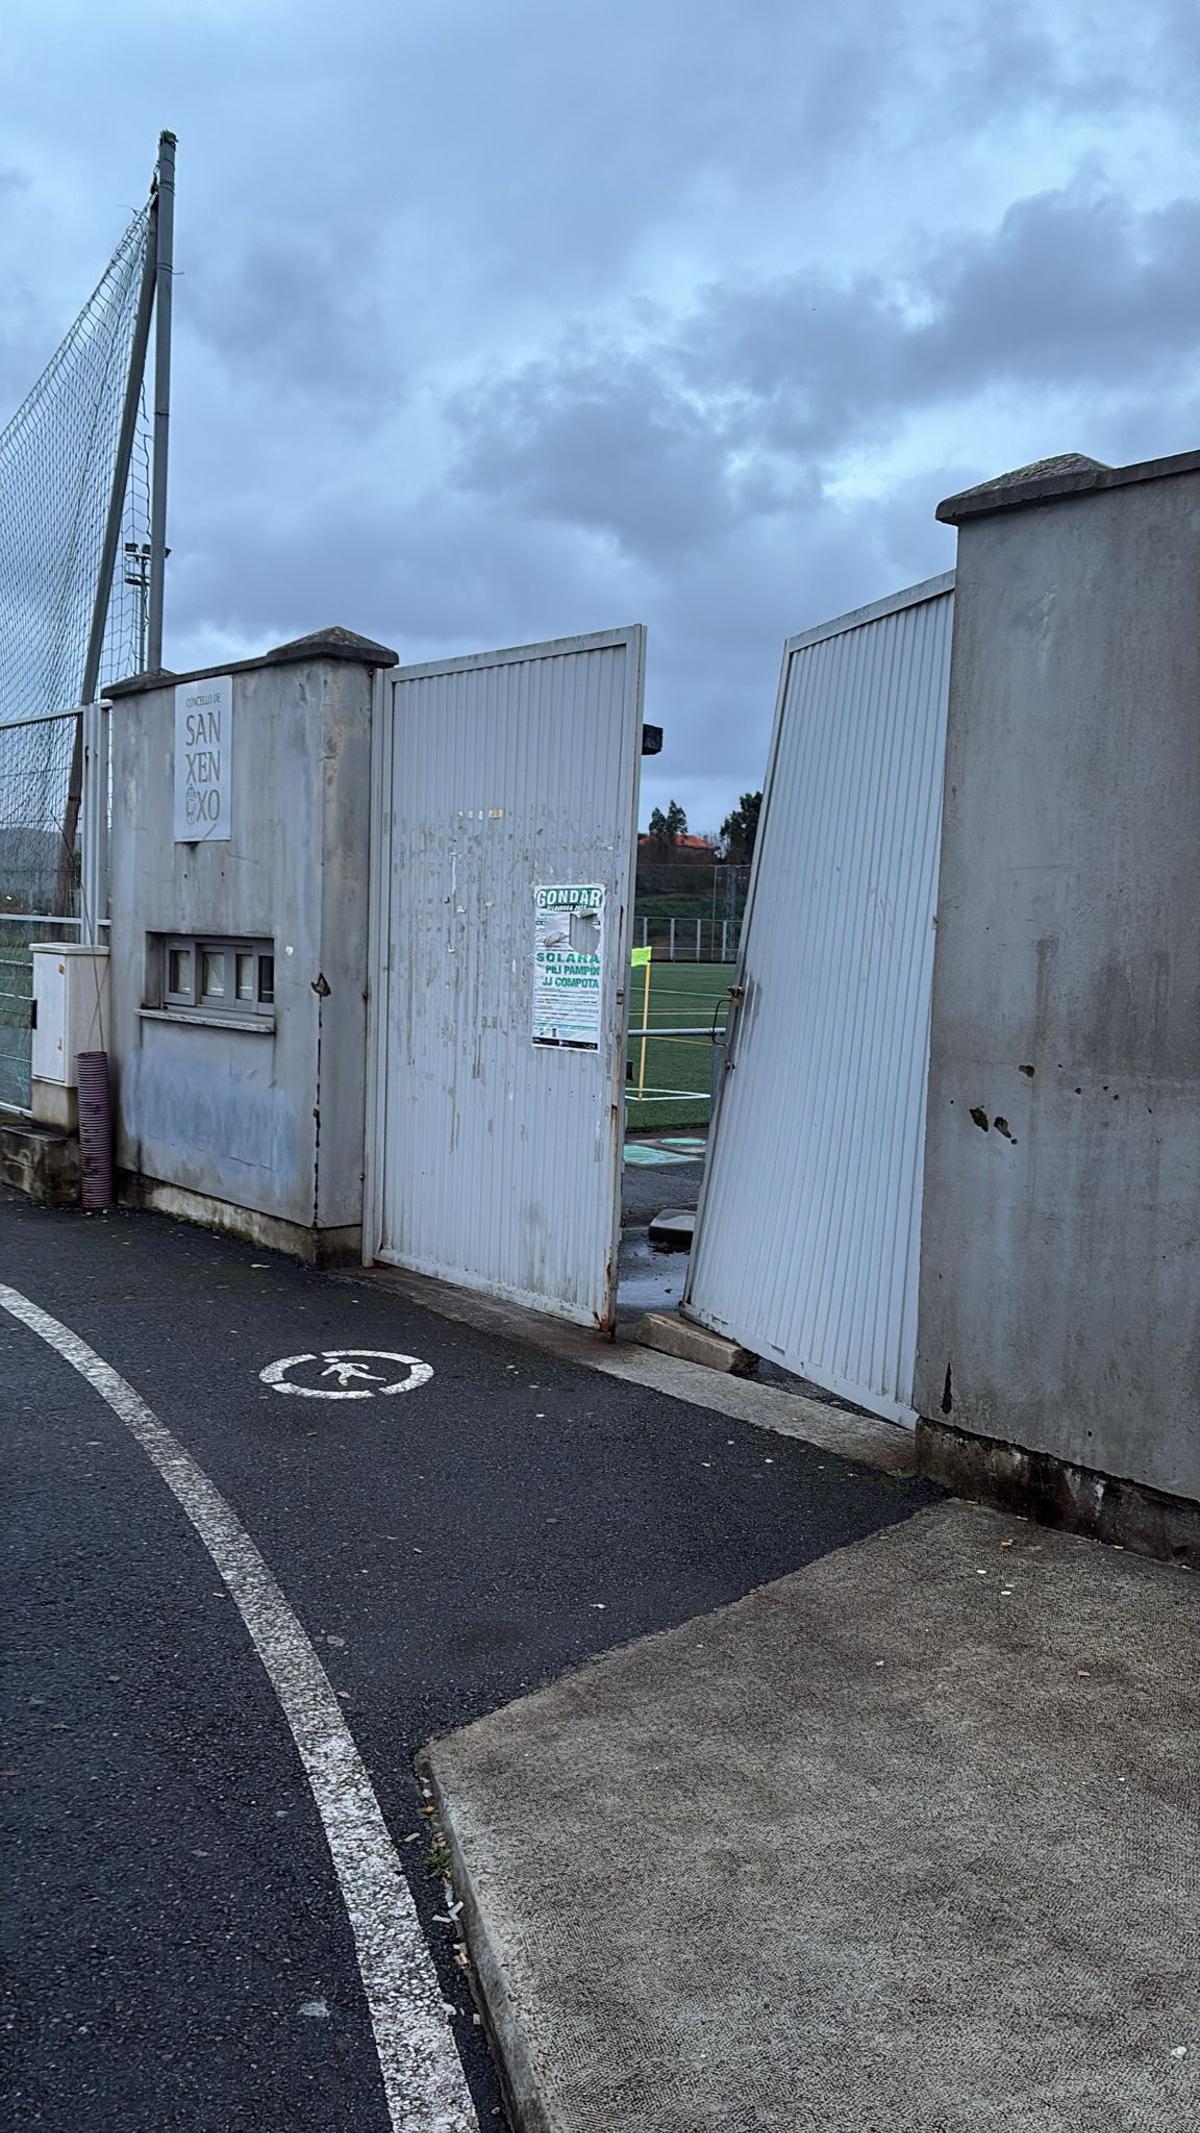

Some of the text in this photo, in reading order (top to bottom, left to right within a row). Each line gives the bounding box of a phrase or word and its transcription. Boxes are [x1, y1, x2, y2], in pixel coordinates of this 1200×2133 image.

[185, 711, 222, 747] SAN
[185, 750, 221, 785] XEN
[196, 789, 220, 822] XO
[537, 889, 602, 908] GONDAR
[536, 952, 600, 963] SOLARA
[545, 965, 562, 975] PILI
[542, 977, 599, 988] JJ COMPOTA
